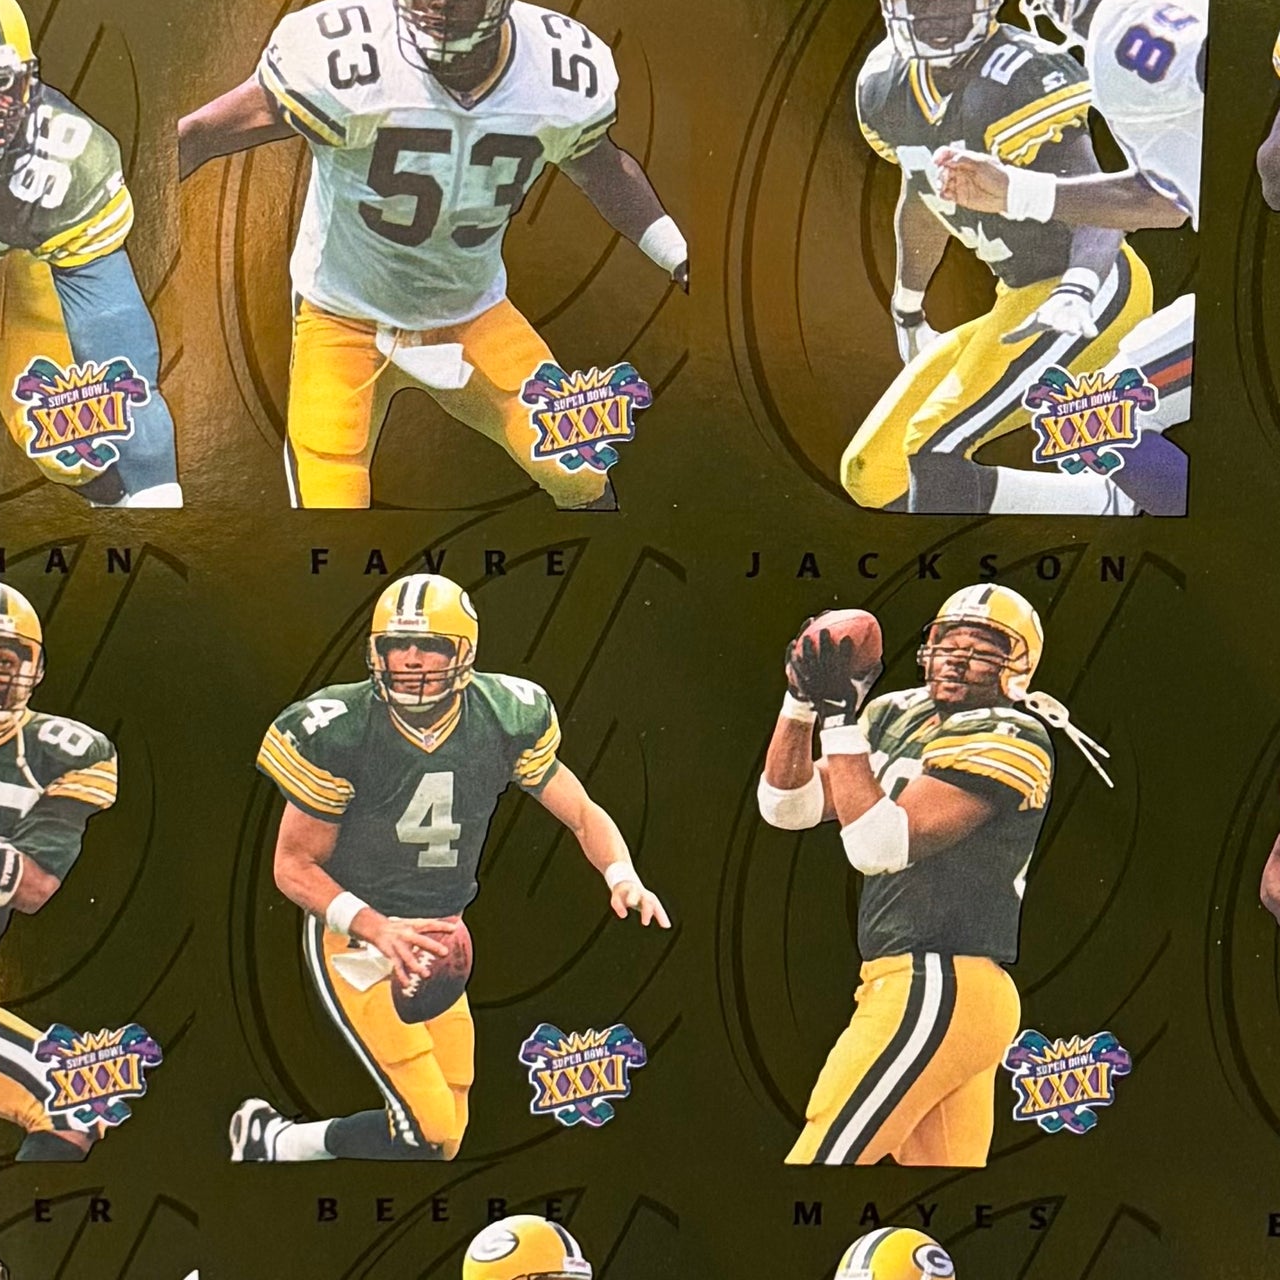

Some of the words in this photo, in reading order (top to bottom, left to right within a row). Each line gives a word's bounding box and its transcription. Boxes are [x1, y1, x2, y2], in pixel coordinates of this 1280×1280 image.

[317, 4, 380, 90] 53
[359, 128, 541, 248] 53
[33, 392, 127, 448] XXXI
[48, 391, 79, 408] SUPER
[82, 382, 110, 398] BOWL
[554, 395, 584, 411] SUPER
[587, 386, 614, 401] BOWL
[1057, 399, 1088, 415] SUPER
[1091, 390, 1119, 405] BOWL
[539, 396, 630, 452] XXXI
[1041, 400, 1134, 456] XXXI
[310, 548, 566, 576] FAVRE
[745, 551, 1126, 583] JACKSON
[395, 771, 461, 868] 4
[51, 1054, 142, 1107] XXXI
[538, 1055, 626, 1107] XXXI
[1021, 1063, 1110, 1113] XXXI
[317, 1197, 563, 1221] BEEBE
[793, 1201, 1049, 1229] MAYES
